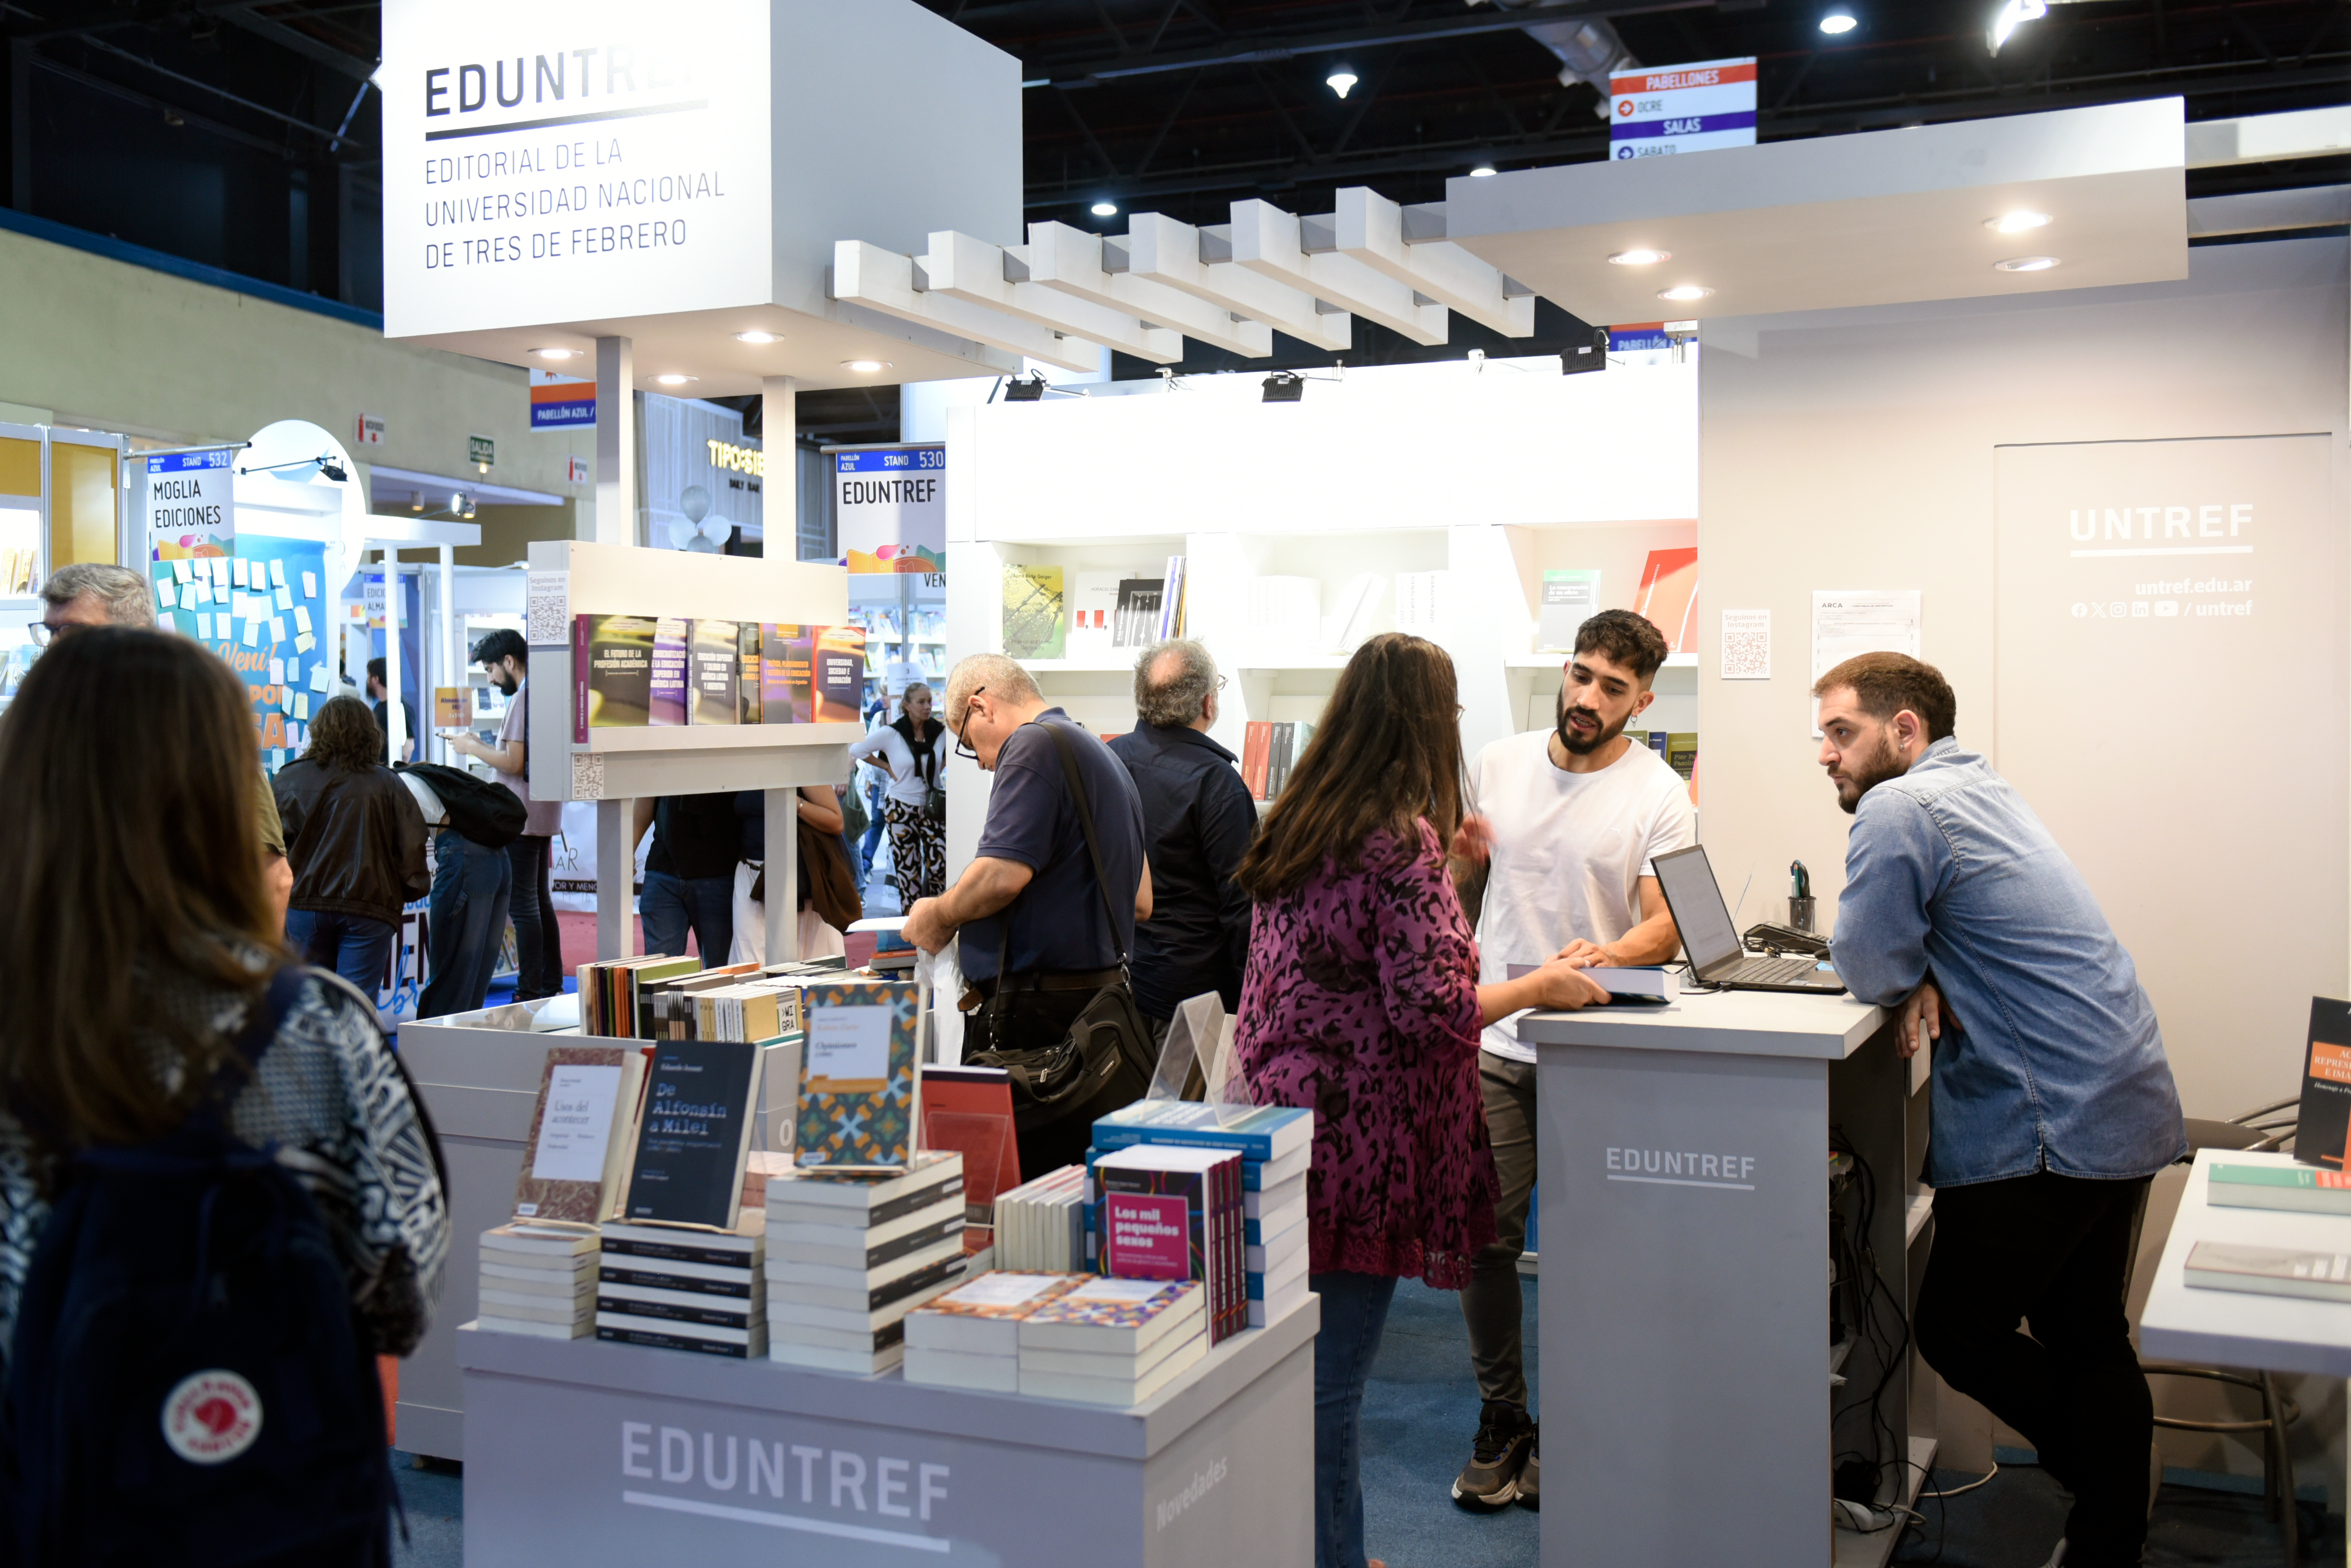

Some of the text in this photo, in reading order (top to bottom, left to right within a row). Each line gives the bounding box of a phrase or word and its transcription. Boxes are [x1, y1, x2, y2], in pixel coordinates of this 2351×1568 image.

[1646, 70, 1719, 90] PABELLONES
[1638, 100, 1663, 113] OCRE
[1663, 118, 1701, 135] SALAS
[426, 138, 622, 184] EDITORIAL DE LA
[426, 171, 725, 227] UNIVERSIDAD NACIONAL
[426, 219, 686, 269] DE TRES DE FEBRERO
[537, 406, 570, 421] PABELLÓN
[571, 406, 588, 419] AZUL
[471, 439, 493, 454] SALIDA
[182, 452, 227, 467] STAND 532
[884, 451, 944, 467] STAND 530
[841, 463, 856, 471] AZUL
[154, 479, 201, 501] MOGLIA
[843, 478, 936, 504] EDUNTREF
[155, 505, 221, 528] EDICIONES
[2070, 504, 2253, 541] UNTREF
[2136, 577, 2252, 595] untref.edu.ar
[2196, 599, 2253, 616] untref
[610, 650, 628, 658] FUTURO
[698, 652, 733, 661] EDUCACIÓN SUPERIOR
[594, 659, 648, 668] PROFESIÓN ACADÉMICA
[661, 659, 685, 668] EDUCACIÓN
[827, 659, 853, 667] UNIVERSIDAD,
[653, 670, 673, 678] SUPERIOR
[701, 671, 716, 680] AMÉRICA
[791, 668, 811, 677] EDUCACIÓN
[828, 676, 851, 684] INNOVACIÓN
[650, 678, 669, 688] AMÉRICA
[782, 1020, 795, 1032] GRA
[2325, 1068, 2331, 1076] E
[656, 1082, 676, 1097] De
[2314, 1081, 2339, 1093] Homenaje
[652, 1100, 727, 1119] Alfonsín
[649, 1119, 709, 1136] a Milei
[1607, 1147, 1754, 1179] EDUNTREF
[1115, 1206, 1160, 1221] Los mil
[1115, 1222, 1179, 1237] pequeños
[1116, 1235, 1153, 1247] sexos
[623, 1421, 949, 1520] EDUNTREF
[1157, 1456, 1227, 1532] Novedades
